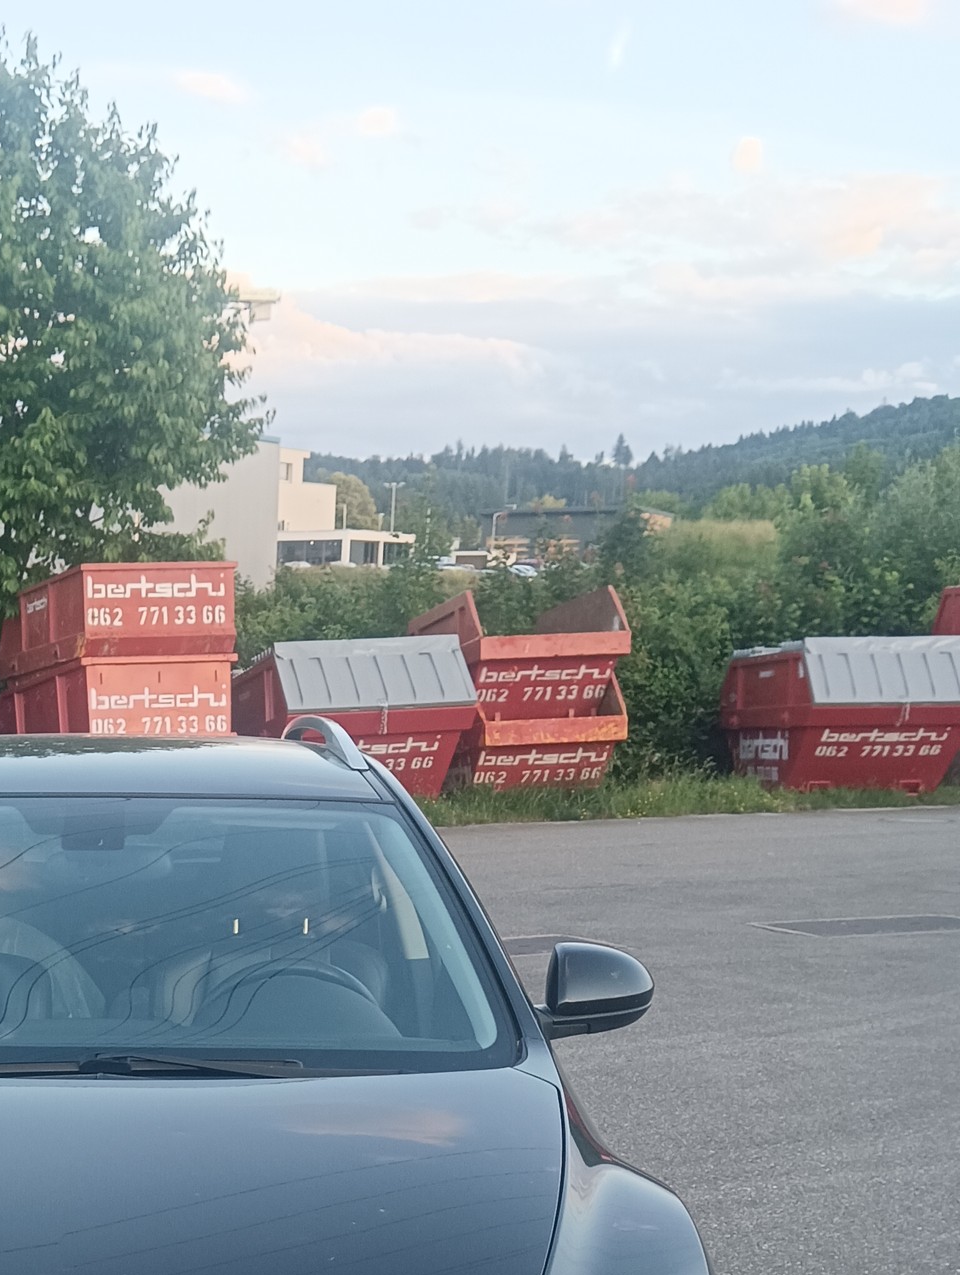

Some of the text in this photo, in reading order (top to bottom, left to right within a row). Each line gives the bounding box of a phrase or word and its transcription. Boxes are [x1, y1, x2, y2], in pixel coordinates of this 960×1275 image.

[87, 573, 226, 599] bertschi
[87, 604, 226, 627] 062 771 33 66
[480, 661, 613, 683] bertschi
[90, 684, 227, 710] bertschi
[476, 684, 607, 703] 062 771 33 66
[92, 715, 227, 735] 062 771 33 66
[820, 726, 952, 743] bertschi
[478, 745, 610, 766] bertschi
[815, 744, 942, 757] 062 771 33 66
[385, 756, 434, 771] 33 66
[473, 771, 507, 784] 062
[521, 769, 550, 784] 771
[554, 768, 576, 781] 33
[580, 766, 602, 781] 66
